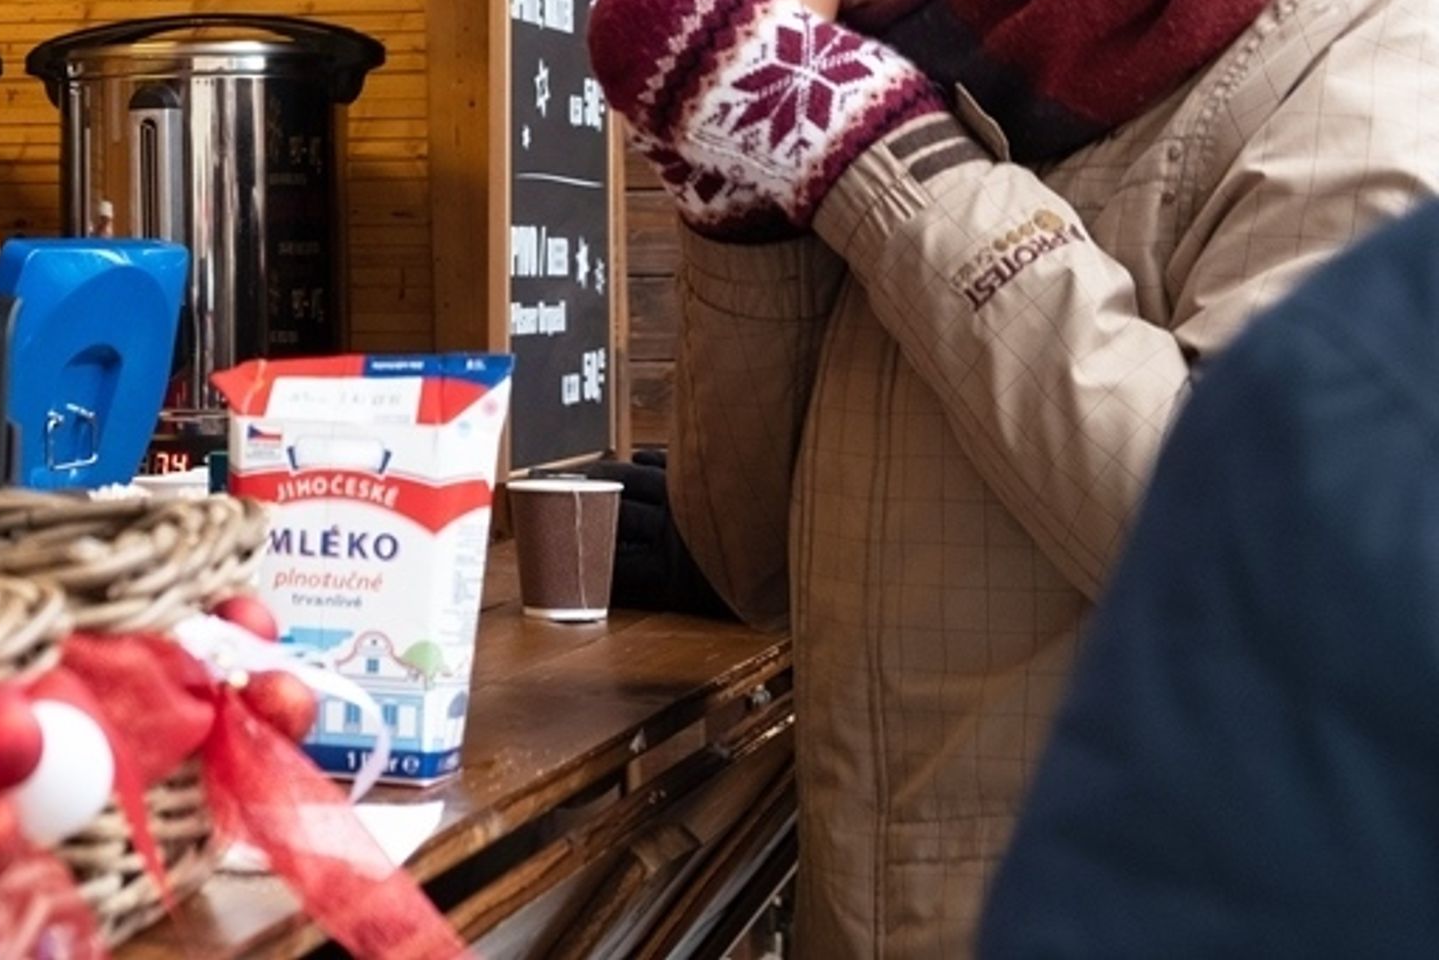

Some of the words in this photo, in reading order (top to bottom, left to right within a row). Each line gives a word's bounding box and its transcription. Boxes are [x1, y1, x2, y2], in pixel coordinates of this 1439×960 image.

[964, 228, 1069, 312] PROTEST
[277, 475, 399, 507] JIHOČESKÉ
[267, 525, 399, 561] MLÉKO
[273, 568, 383, 592] plnotučné
